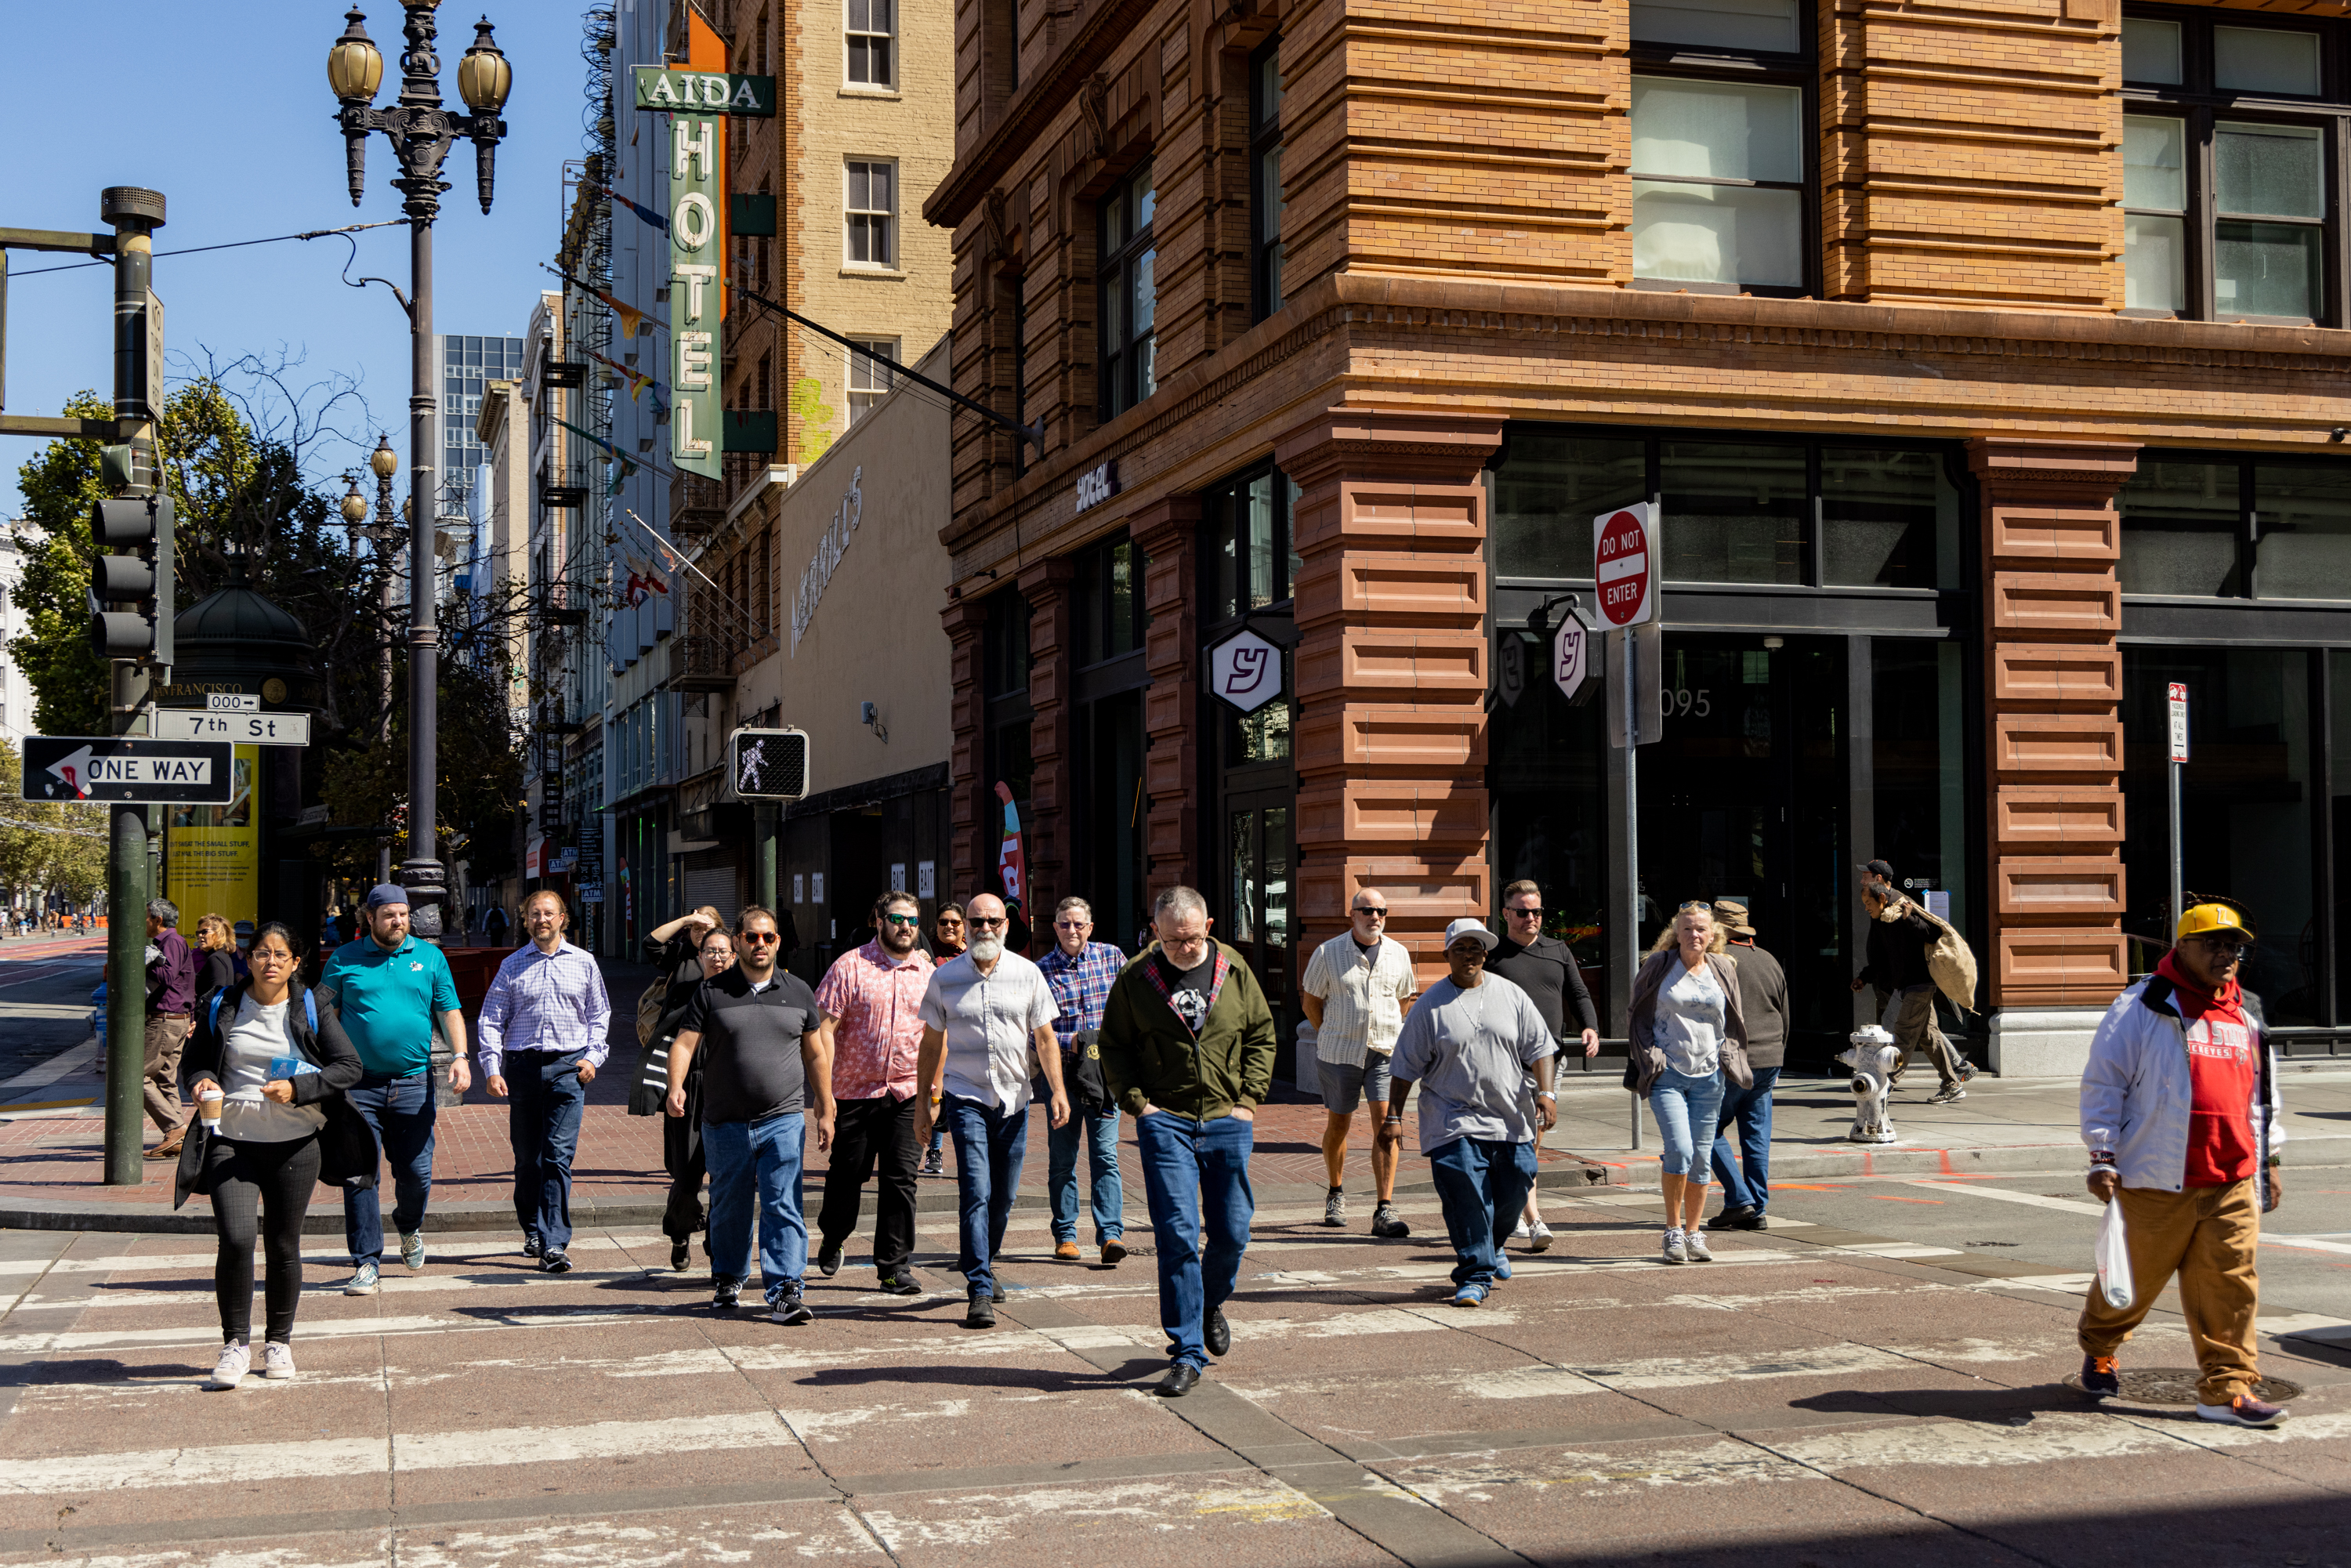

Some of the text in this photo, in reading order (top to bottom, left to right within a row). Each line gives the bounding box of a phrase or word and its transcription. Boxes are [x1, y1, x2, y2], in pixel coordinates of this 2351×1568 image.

[649, 72, 762, 109] AIDA
[675, 120, 717, 453] HOTEL
[152, 304, 161, 331] NO
[153, 360, 160, 381] ON
[1603, 529, 1640, 556] DO NOT
[1607, 581, 1638, 606] ENTER
[170, 683, 242, 696] FRANCISCO
[212, 696, 241, 708] 000
[189, 717, 276, 737] 7th St
[2174, 721, 2178, 730] AT
[2175, 732, 2183, 741] TIMES
[87, 759, 205, 781] ONE WAY
[813, 878, 823, 898] BAIT
[893, 870, 904, 892] BAIT
[921, 867, 933, 892] BAIT
[2212, 1020, 2249, 1051] STATE
[2188, 1045, 2231, 1057] CKEYES
